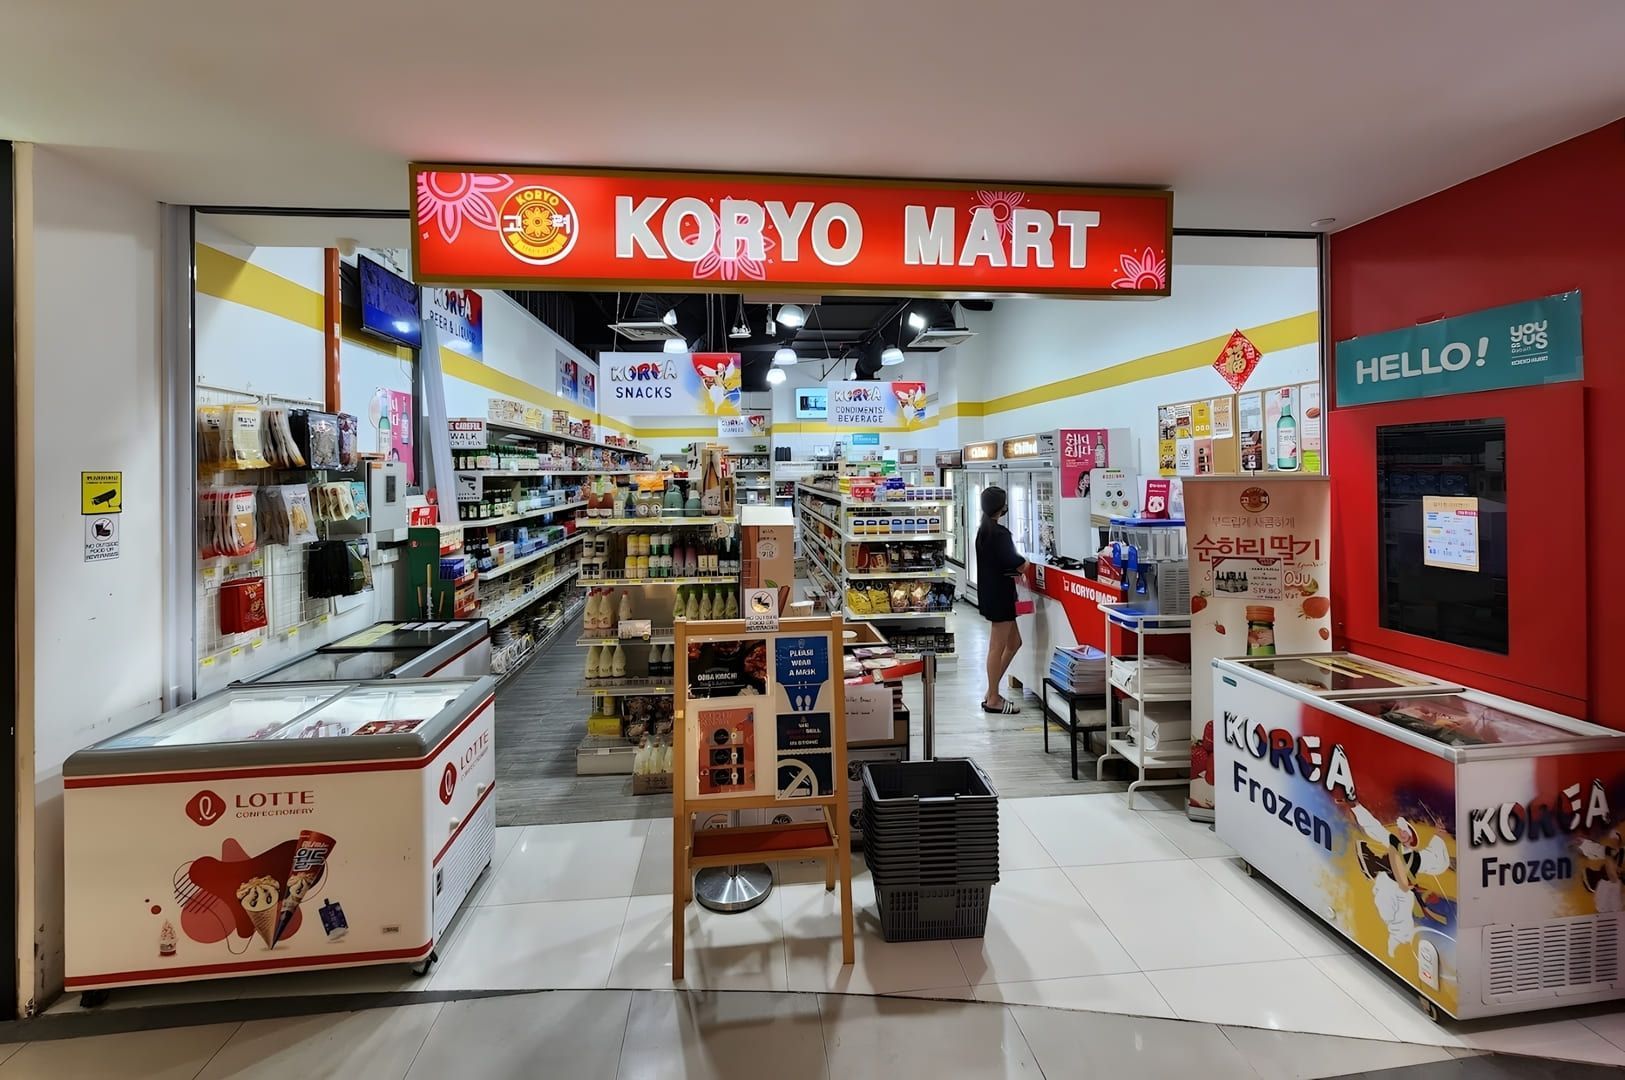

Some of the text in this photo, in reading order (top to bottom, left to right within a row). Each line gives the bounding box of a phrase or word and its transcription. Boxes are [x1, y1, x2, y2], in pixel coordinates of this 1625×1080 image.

[515, 189, 560, 206] KORYO
[615, 196, 1100, 269] KORYO MART
[430, 310, 447, 331] BEER
[611, 360, 678, 381] KOREA
[1356, 337, 1489, 384] HELLO!
[616, 386, 672, 398] SNACKS
[835, 386, 881, 402] KOREA
[836, 406, 886, 414] CONDIMENTS/
[838, 414, 884, 423] BEVERAGE
[1193, 534, 1320, 566] 순하리 딸기
[1071, 583, 1118, 605] KORYO MART
[789, 648, 814, 657] PLEASE
[795, 668, 816, 676] MASK
[460, 729, 488, 770] LOTTE
[1224, 711, 1356, 801] KOREA
[235, 790, 314, 808] LOTTE
[1233, 760, 1333, 852] Frozen
[235, 807, 314, 818] CONFECTIONERY
[1469, 778, 1610, 847] KOREA
[1481, 856, 1572, 888] Frozen
